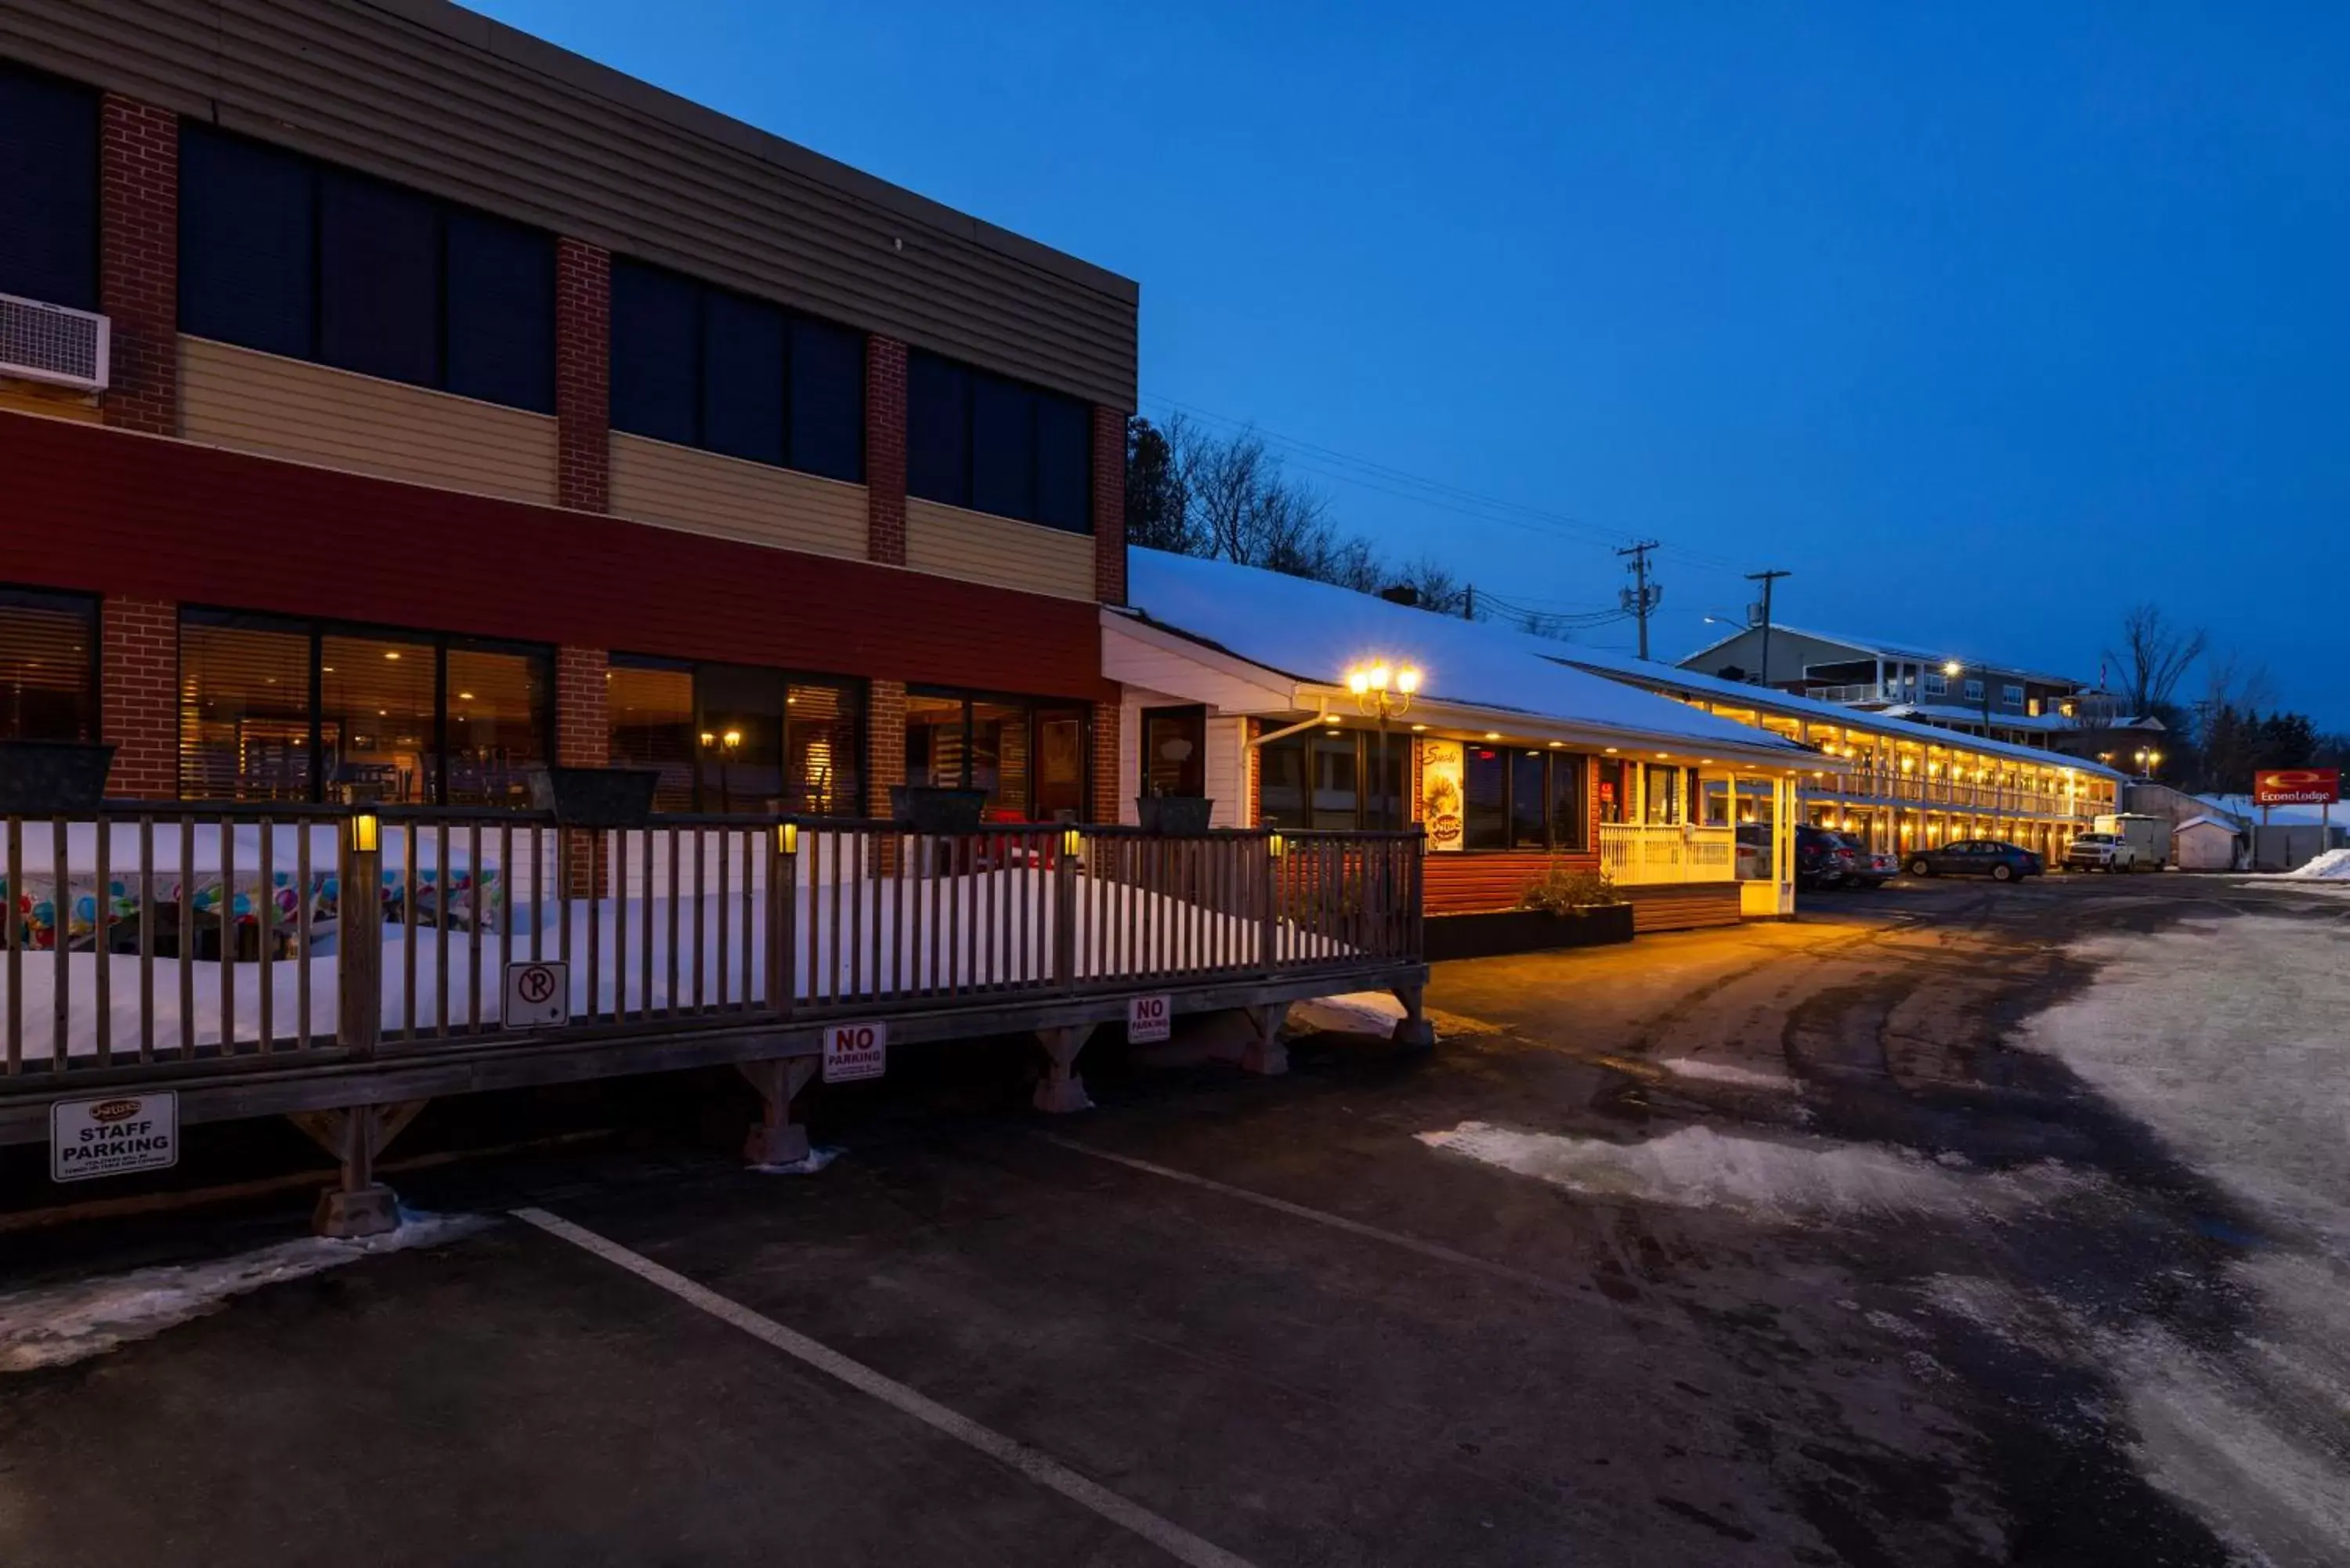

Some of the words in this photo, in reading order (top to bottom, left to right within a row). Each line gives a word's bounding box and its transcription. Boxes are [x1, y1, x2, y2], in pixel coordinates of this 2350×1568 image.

[1137, 999, 1162, 1020] NO
[837, 1028, 874, 1053] NO
[829, 1050, 880, 1065] PARKING
[80, 1121, 152, 1142] STAFF
[63, 1136, 168, 1162] PARKING
